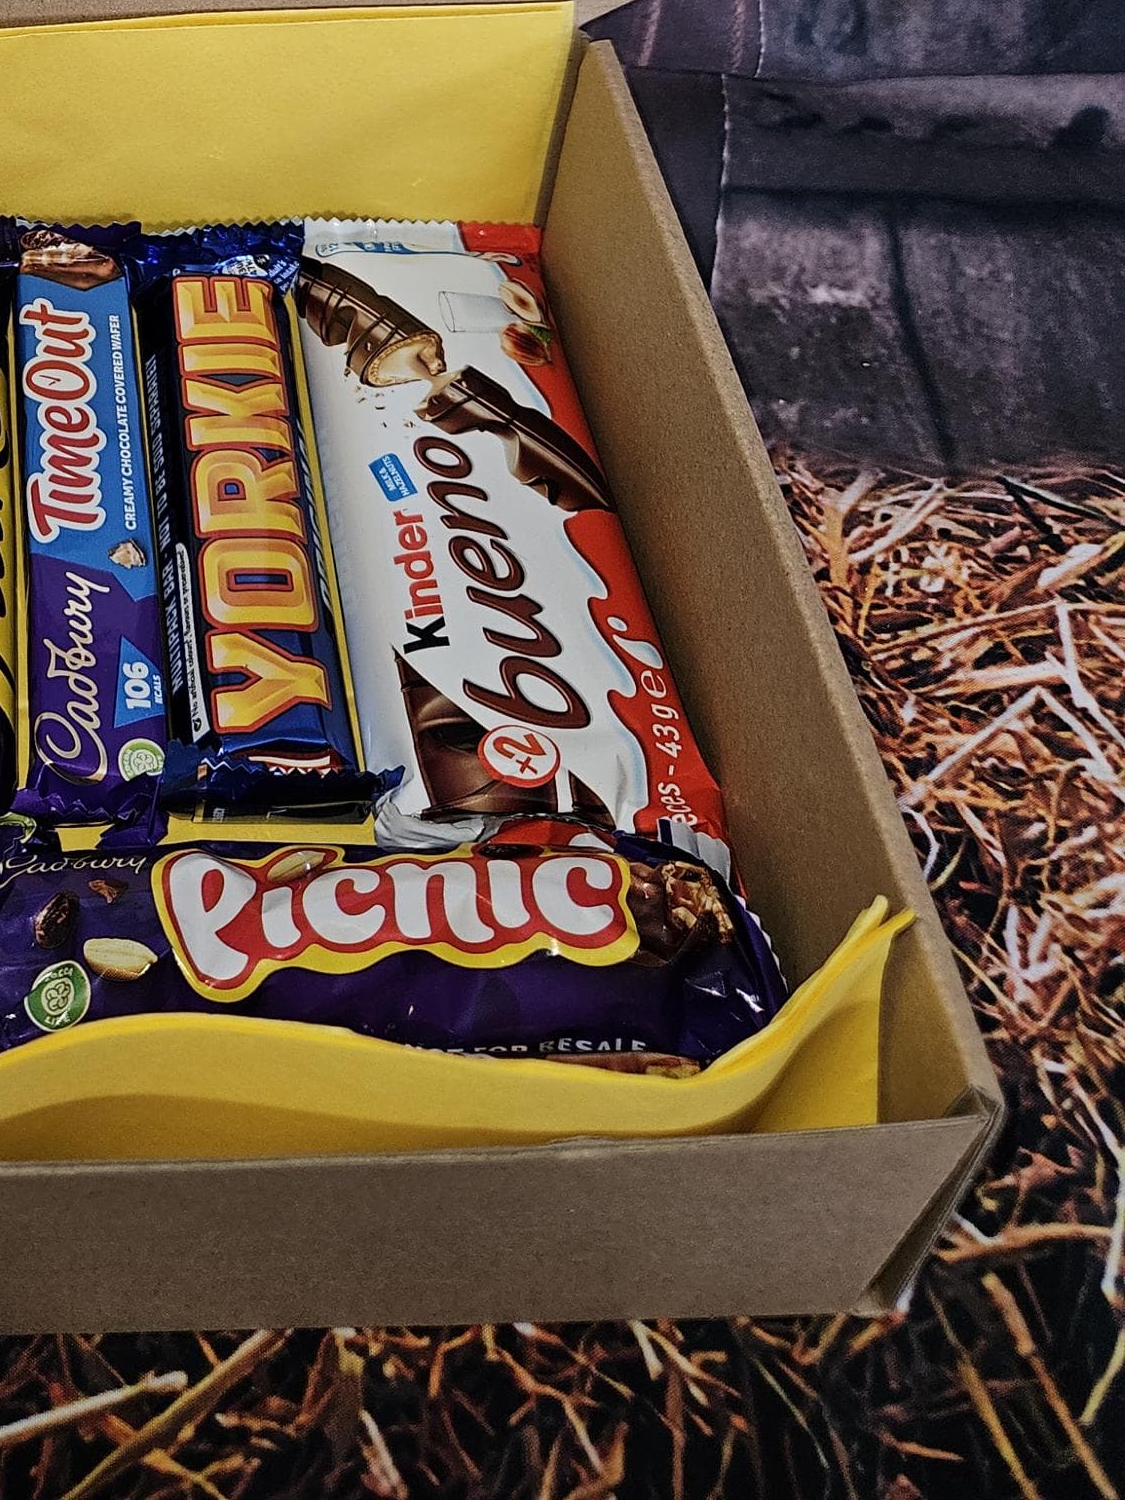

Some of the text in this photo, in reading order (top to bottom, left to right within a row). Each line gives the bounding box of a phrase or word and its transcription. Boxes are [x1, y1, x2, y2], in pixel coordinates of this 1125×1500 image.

[22, 301, 102, 539] TimeOut
[110, 315, 137, 531] CREAMY CHOCOLATE COVERED WAFER
[145, 354, 162, 436] SEPARATELY
[151, 434, 164, 472] SOLD
[154, 469, 166, 495] BE
[156, 492, 168, 519] TO
[158, 517, 171, 552] NOT
[172, 276, 332, 735] YORKIE
[162, 560, 175, 600] BAR
[392, 509, 451, 656] Kinder
[413, 435, 591, 730] bueno
[34, 570, 111, 784] Cadbury
[124, 661, 152, 710] 106
[165, 596, 184, 695] MULTIPACK
[152, 674, 163, 704] KCALS
[658, 782, 698, 828] eces
[168, 850, 617, 982] Picnic
